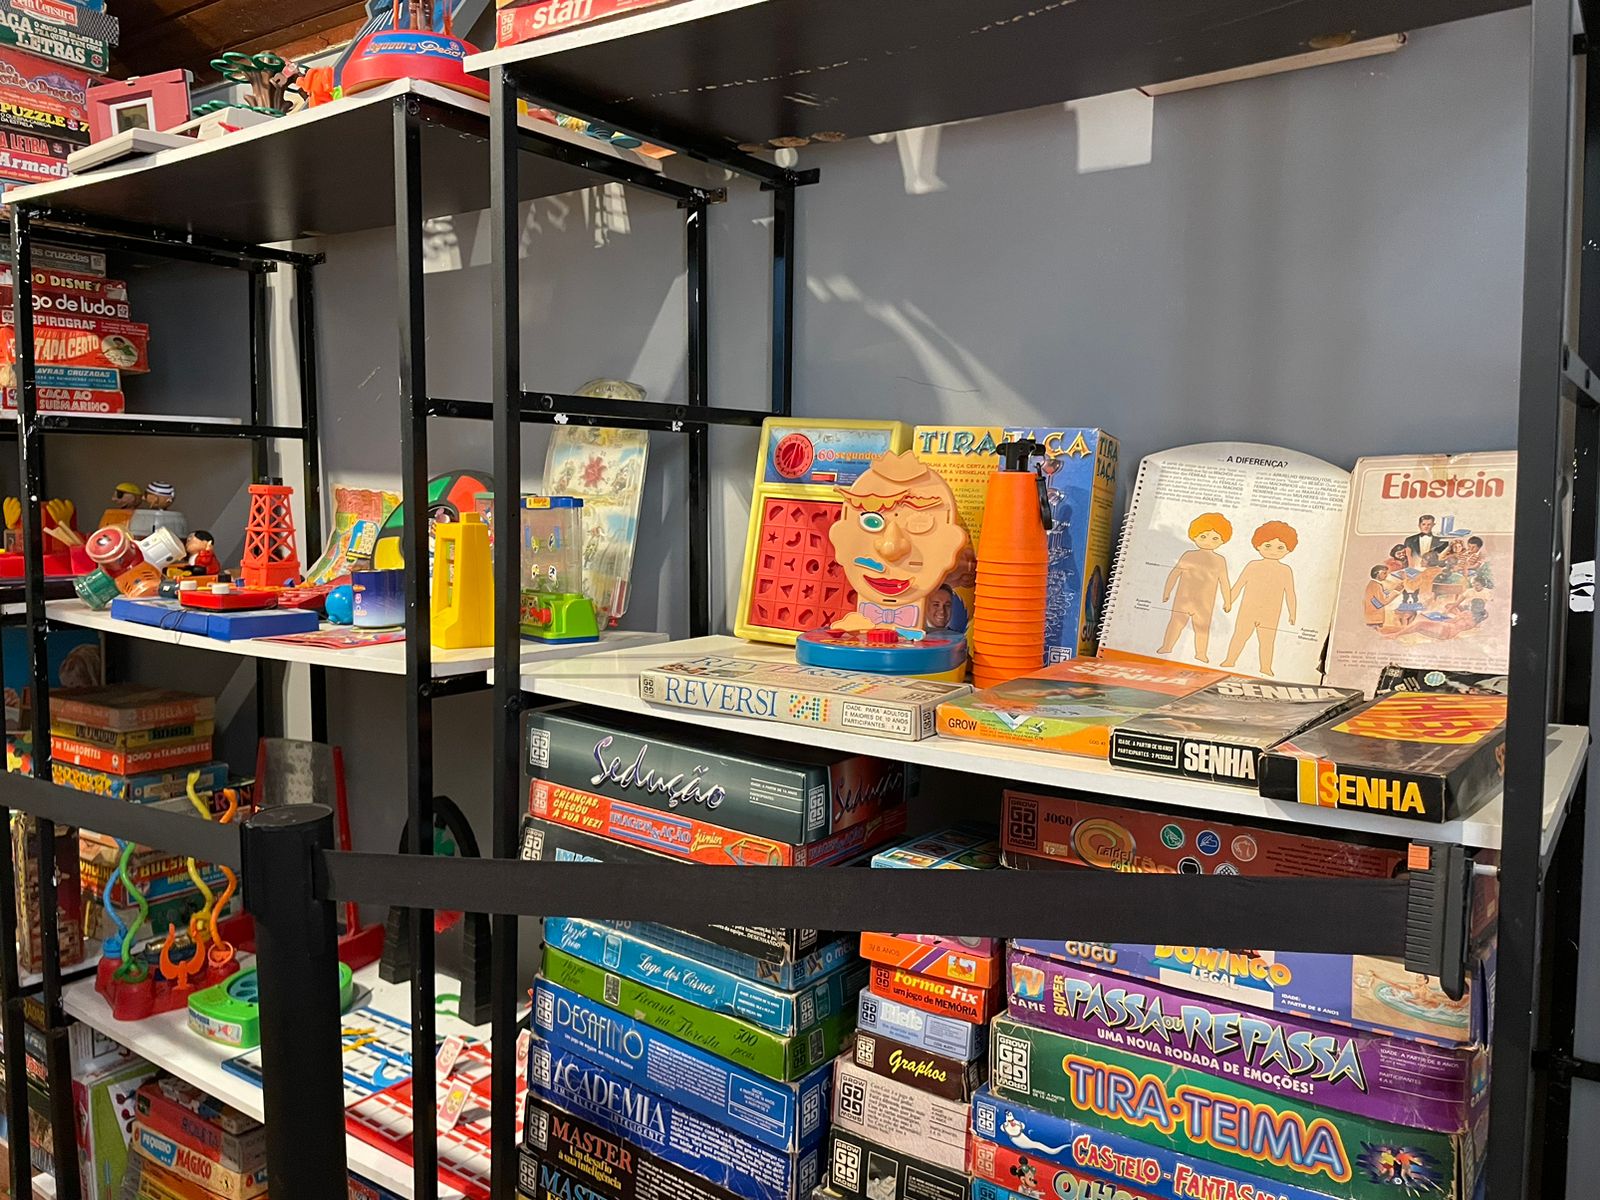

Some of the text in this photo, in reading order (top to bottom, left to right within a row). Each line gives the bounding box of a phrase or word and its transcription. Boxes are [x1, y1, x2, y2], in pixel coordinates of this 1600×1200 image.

[16, 31, 86, 64] LETRAS
[0, 102, 66, 127] PUZZLE
[10, 133, 50, 155] LETRA
[0, 151, 75, 178] Armadi
[44, 249, 90, 263] cruzadas
[49, 275, 102, 292] DISNEY
[55, 294, 78, 312] de
[80, 296, 116, 317] ludo
[34, 334, 100, 361] TAPA CERTO
[67, 369, 111, 378] CRUZADAS
[39, 389, 93, 401] CAÇA AO
[39, 400, 110, 413] SUBMARINO
[917, 430, 997, 457] TIRA
[1098, 437, 1119, 460] TIRA
[817, 449, 836, 462] 60
[1227, 455, 1288, 468] A DIFERENÇA?
[1097, 458, 1117, 487] TAÇA
[1381, 471, 1505, 500] Einstein
[1067, 665, 1190, 686] SENHA
[664, 676, 778, 718] REVERSI
[1217, 681, 1348, 701] SENHA
[849, 712, 873, 721] MAIORES
[891, 716, 909, 726] ANOS
[863, 706, 881, 715] PARA
[881, 709, 909, 718] ADULTOS
[948, 717, 978, 732] GROW
[63, 740, 102, 760] TAMBORETES
[161, 742, 211, 759] TAMBORETES
[1183, 741, 1256, 780] SENHA
[590, 735, 726, 809] Sedução
[553, 788, 600, 809] CRIANÇAS,
[1319, 770, 1426, 814] SENHA
[553, 799, 589, 815] CHEGOU
[552, 809, 604, 829] A SUA VEZ!
[1043, 812, 1073, 827] JOGO
[561, 922, 588, 939] Puzzle
[561, 935, 581, 950] Grow
[638, 953, 717, 995] Lago dos Cisnes
[1154, 944, 1293, 987] DOMINGO
[893, 969, 979, 1005] Forma-Fix
[1190, 966, 1239, 990] LEGAL
[893, 987, 978, 1018] um jogo de MEMÓRIA
[1009, 991, 1046, 1013] GAME
[1053, 974, 1070, 1017] SUPER
[1281, 993, 1301, 1001] IDADE:
[1287, 1001, 1307, 1009] PARTIR
[1322, 1008, 1340, 1016] ANOS
[733, 1028, 758, 1047] 500
[999, 1035, 1028, 1050] GROW
[1064, 977, 1368, 1093] PASSA OU REPASSA
[888, 1049, 947, 1083] Graphos
[1097, 1028, 1315, 1096] UMA NOVA RODADA DE EMOÇÕES!
[842, 1076, 866, 1087] GROW
[553, 1058, 666, 1134] ACADEMIA
[611, 1111, 666, 1146] INTELIGENTE
[552, 1116, 633, 1174] MASTER
[836, 1141, 861, 1154] GROW
[569, 1146, 612, 1174] Um desafio
[1072, 1134, 1161, 1185] CASTELO
[563, 1154, 577, 1166] sua
[577, 1157, 622, 1190] inteligência
